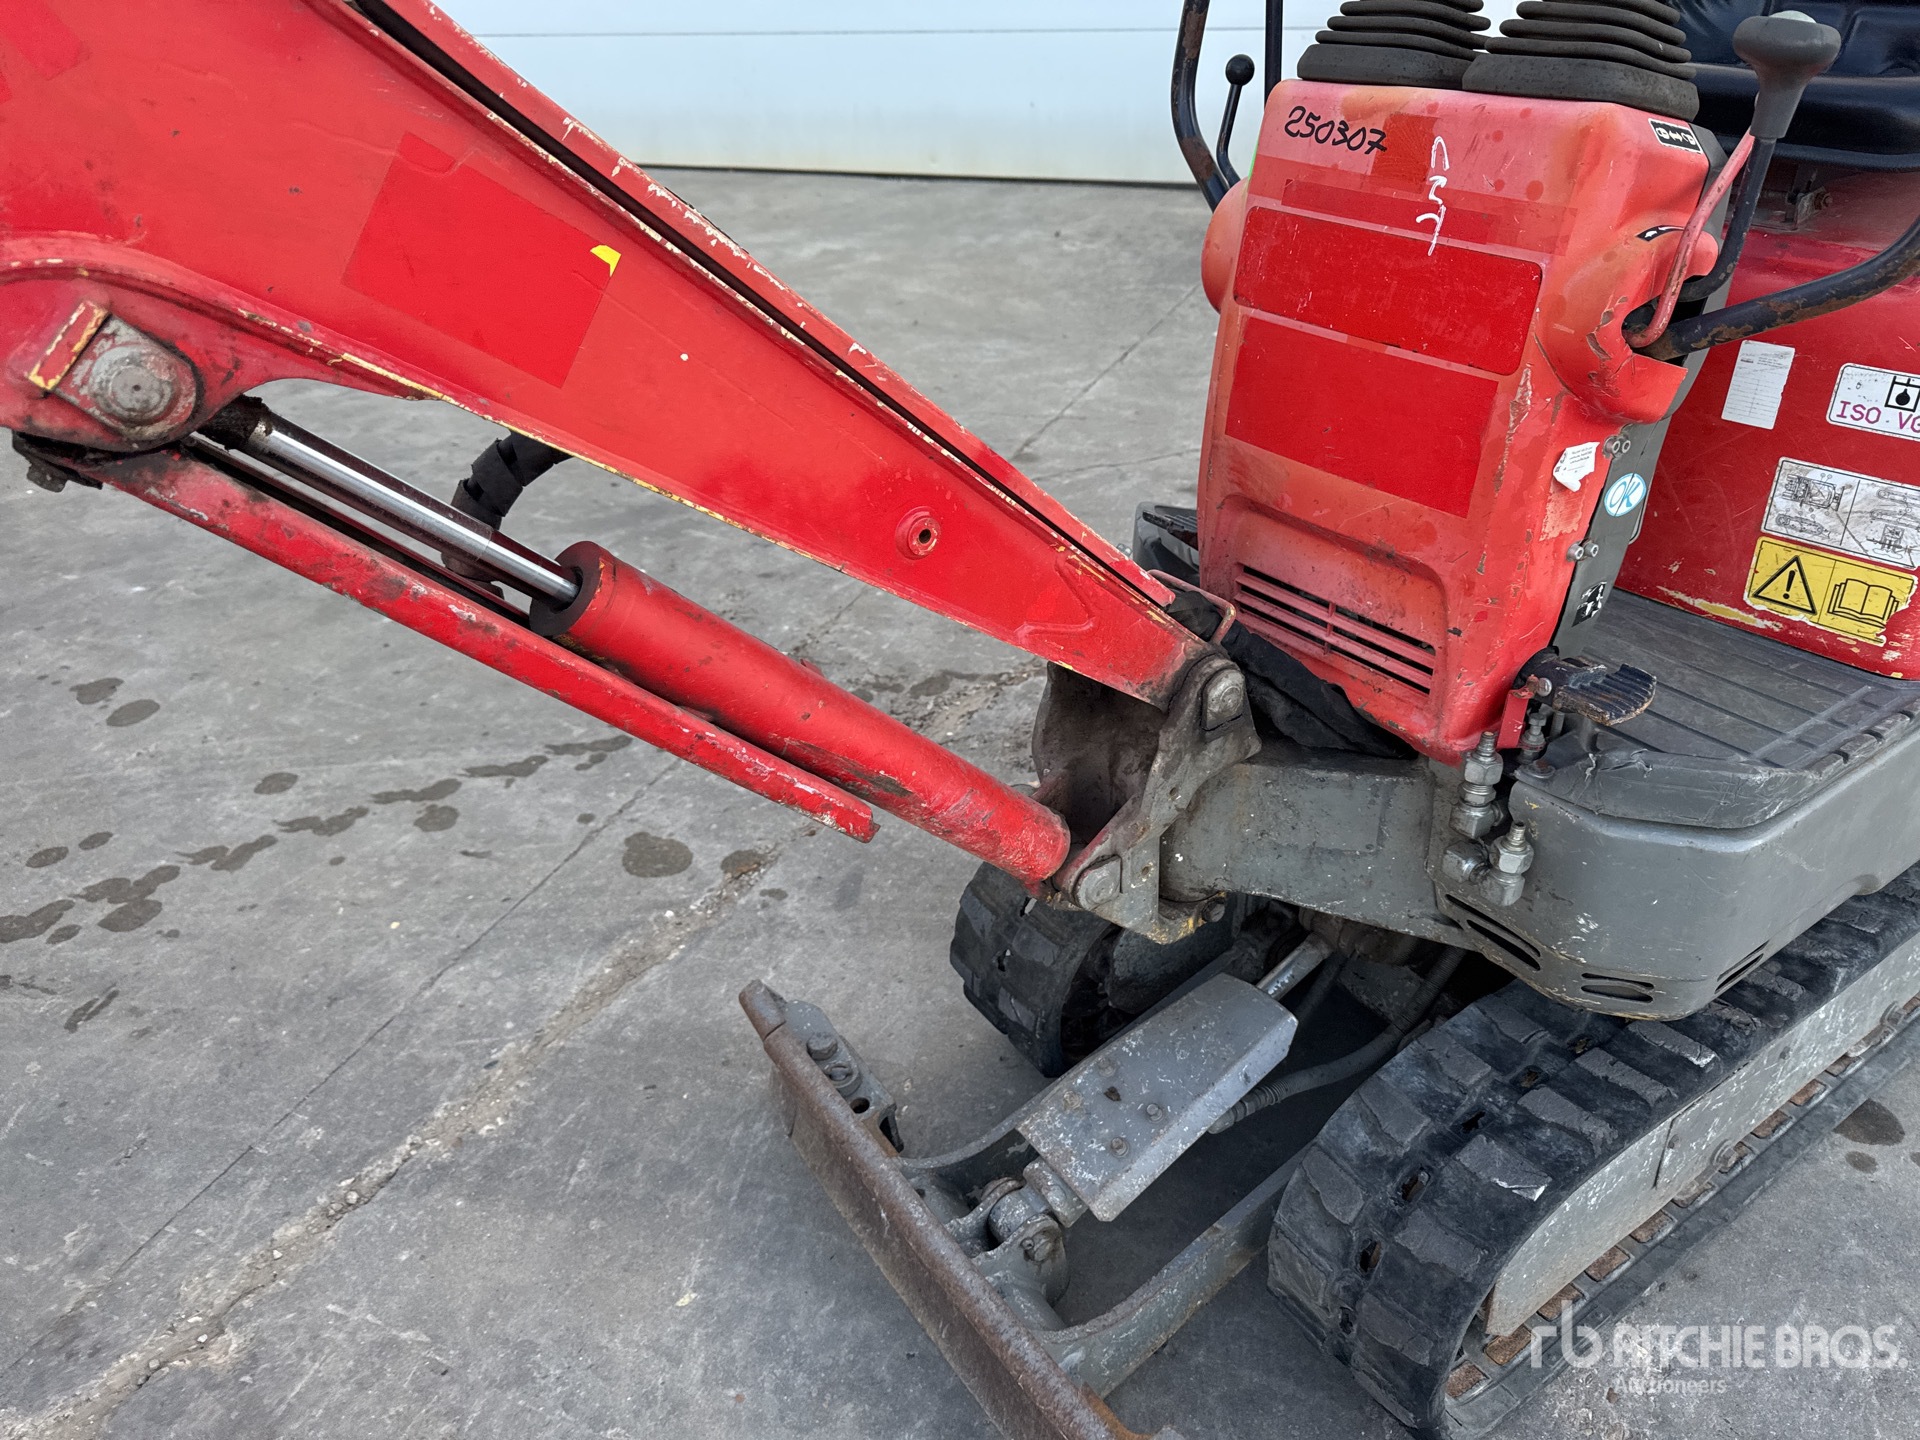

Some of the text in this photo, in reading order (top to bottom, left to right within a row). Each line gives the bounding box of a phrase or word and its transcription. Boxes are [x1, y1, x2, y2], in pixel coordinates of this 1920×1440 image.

[1284, 105, 1388, 155] 250307
[1836, 400, 1881, 424] ISO
[1609, 480, 1642, 509] OK
